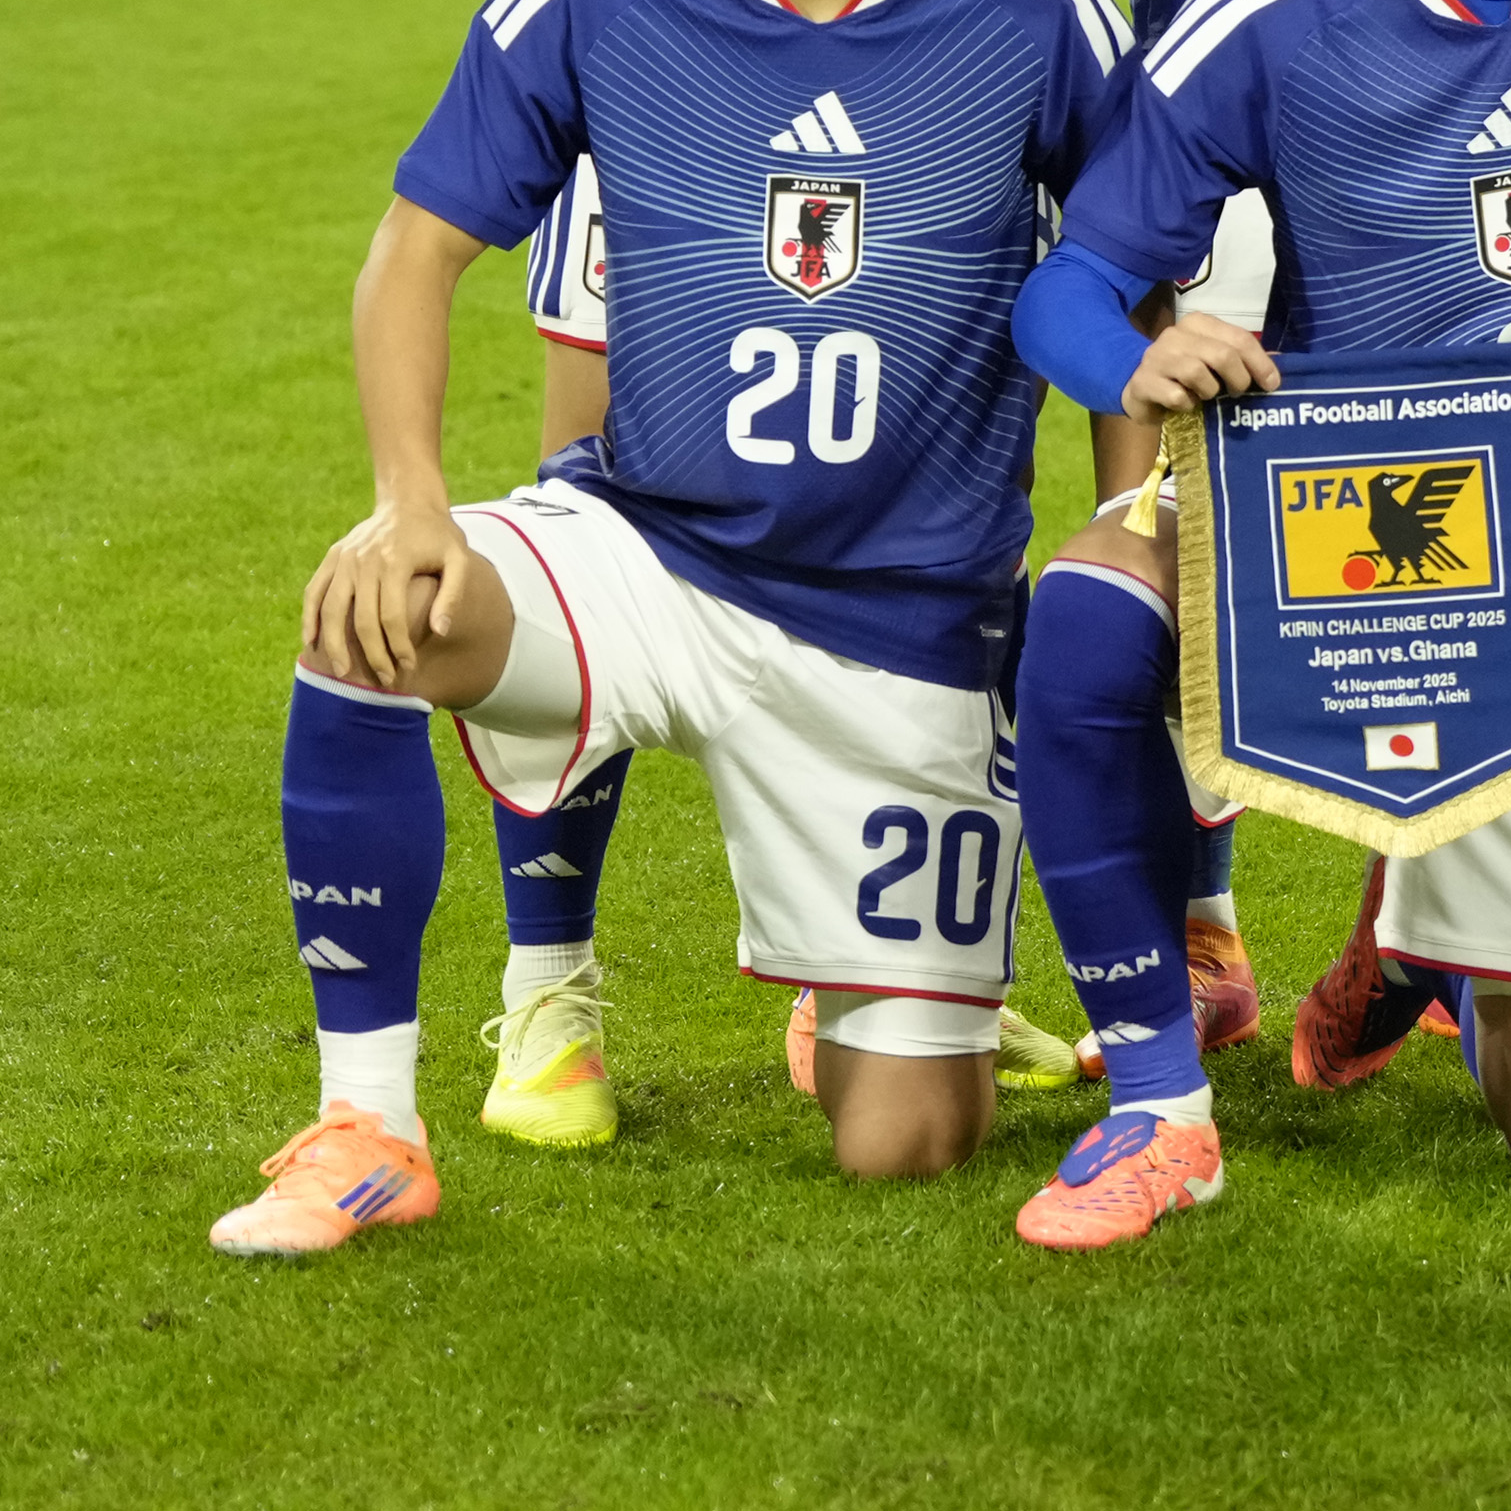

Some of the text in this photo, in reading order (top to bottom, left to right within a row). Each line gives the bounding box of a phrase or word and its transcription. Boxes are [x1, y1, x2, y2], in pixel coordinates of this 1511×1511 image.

[790, 180, 841, 193] JAPAN
[790, 260, 831, 279] JFA
[726, 327, 881, 465] 20
[1230, 405, 1295, 431] Japan
[1299, 399, 1393, 425] Football
[1287, 477, 1363, 512] JFA
[1279, 610, 1506, 638] KIRIN CHALLENGE CUP 2025
[1308, 646, 1373, 671] Japan
[1332, 673, 1457, 693] 14 November 2025
[1321, 697, 1368, 713] Toyota
[1435, 689, 1470, 704] Aichi
[286, 874, 382, 907] PAN
[857, 805, 1001, 947] 20
[1063, 948, 1161, 983] APAN
